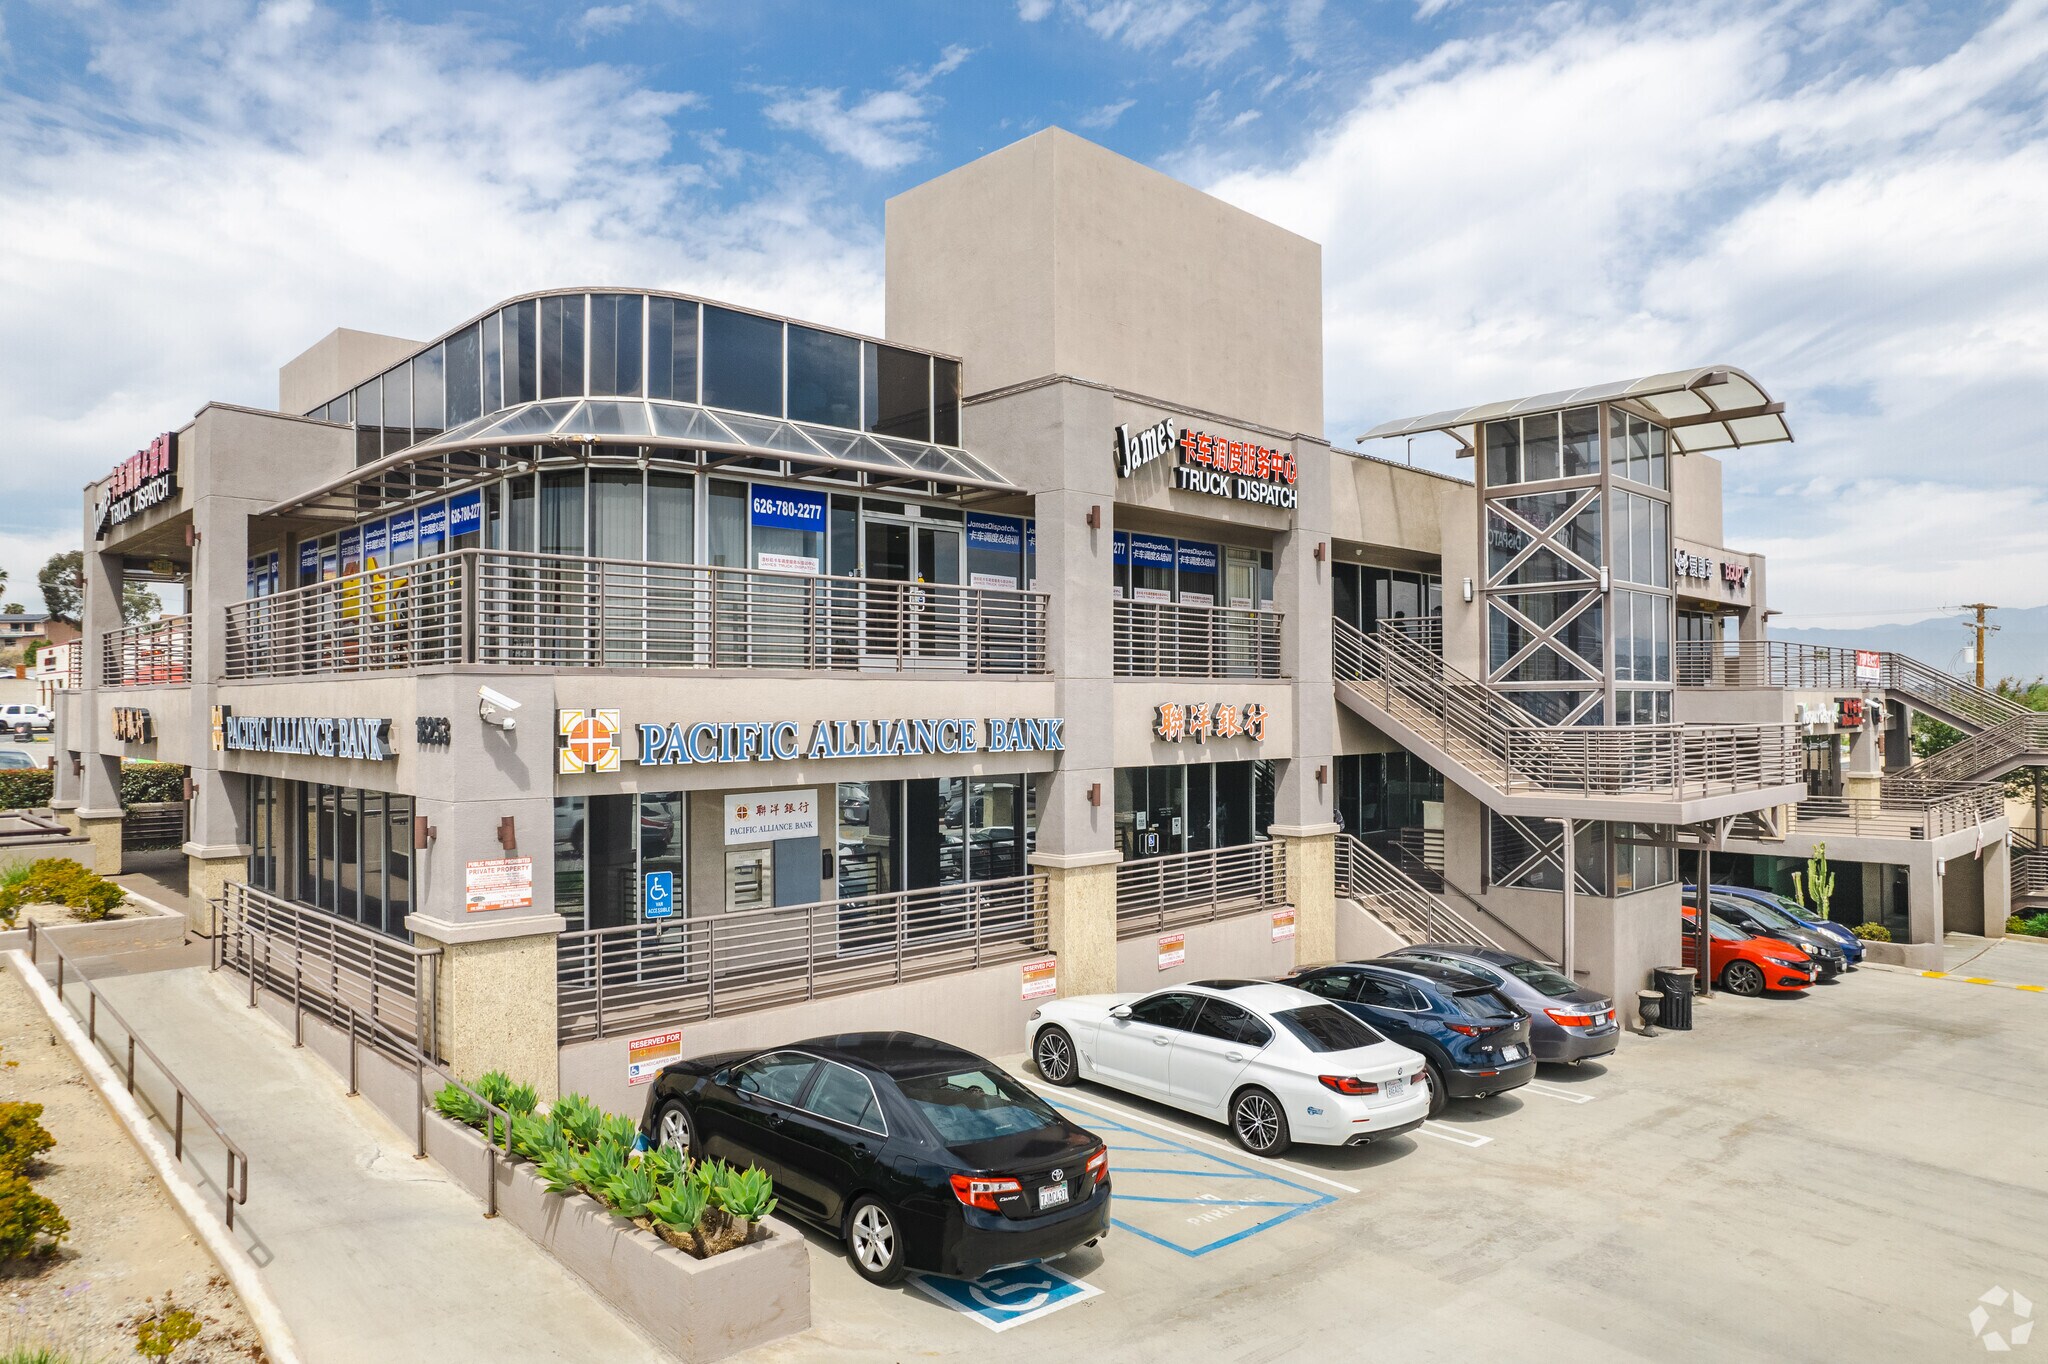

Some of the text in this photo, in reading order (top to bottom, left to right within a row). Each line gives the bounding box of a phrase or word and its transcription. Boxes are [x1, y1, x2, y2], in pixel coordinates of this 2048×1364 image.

[1120, 418, 1176, 479] James
[1180, 428, 1297, 485] 卡车调度服务中心
[1179, 466, 1298, 510] TRUCK DISPATCH
[110, 475, 169, 526] TRUCK DISPATCH
[753, 497, 822, 520] 626-780-2277
[451, 502, 480, 525] 626-780-227
[1157, 701, 1269, 745] 聯洋銀行
[227, 716, 384, 761] PACIFIC ALLIANCE BANK
[639, 717, 1066, 766] PACIFIC ALLIANCE BANK
[755, 801, 810, 817] 聯洋銀行
[729, 820, 814, 836] PACIFIC ALLIANCE BANK
[469, 865, 530, 875] PRIVATE PROPERTY
[1046, 960, 1055, 968] FOR
[630, 1033, 680, 1049] RESERVED FOR
[640, 1058, 669, 1067] HANDICAPPED
